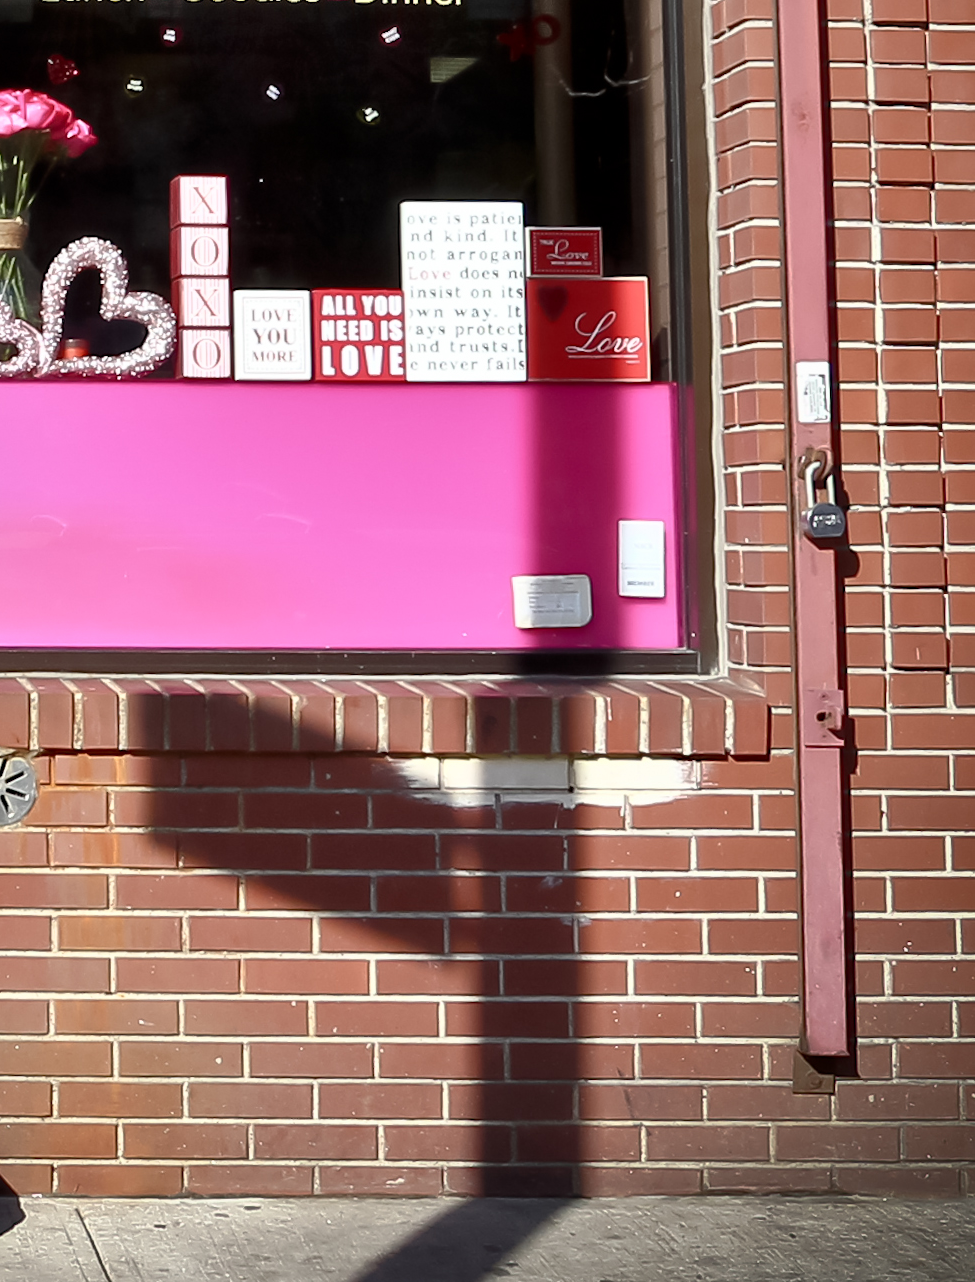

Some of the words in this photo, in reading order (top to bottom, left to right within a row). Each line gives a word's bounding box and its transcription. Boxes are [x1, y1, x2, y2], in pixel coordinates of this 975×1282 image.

[447, 212, 461, 225] is
[504, 229, 518, 242] It
[407, 248, 436, 261] not
[546, 238, 589, 260] Love
[408, 266, 451, 280] Love
[459, 266, 499, 280] does
[410, 285, 461, 299] insist
[470, 288, 492, 299] on
[501, 285, 524, 299] its
[321, 294, 357, 317] ALL
[361, 294, 403, 317] YOU
[507, 305, 521, 318] It
[251, 308, 297, 323] LOVE
[253, 327, 297, 346] YOU
[320, 319, 374, 342] NEED
[380, 319, 404, 342] IS
[565, 310, 643, 354] Love
[251, 350, 298, 363] MORE
[321, 344, 405, 377] LOVE
[428, 360, 478, 371] never
